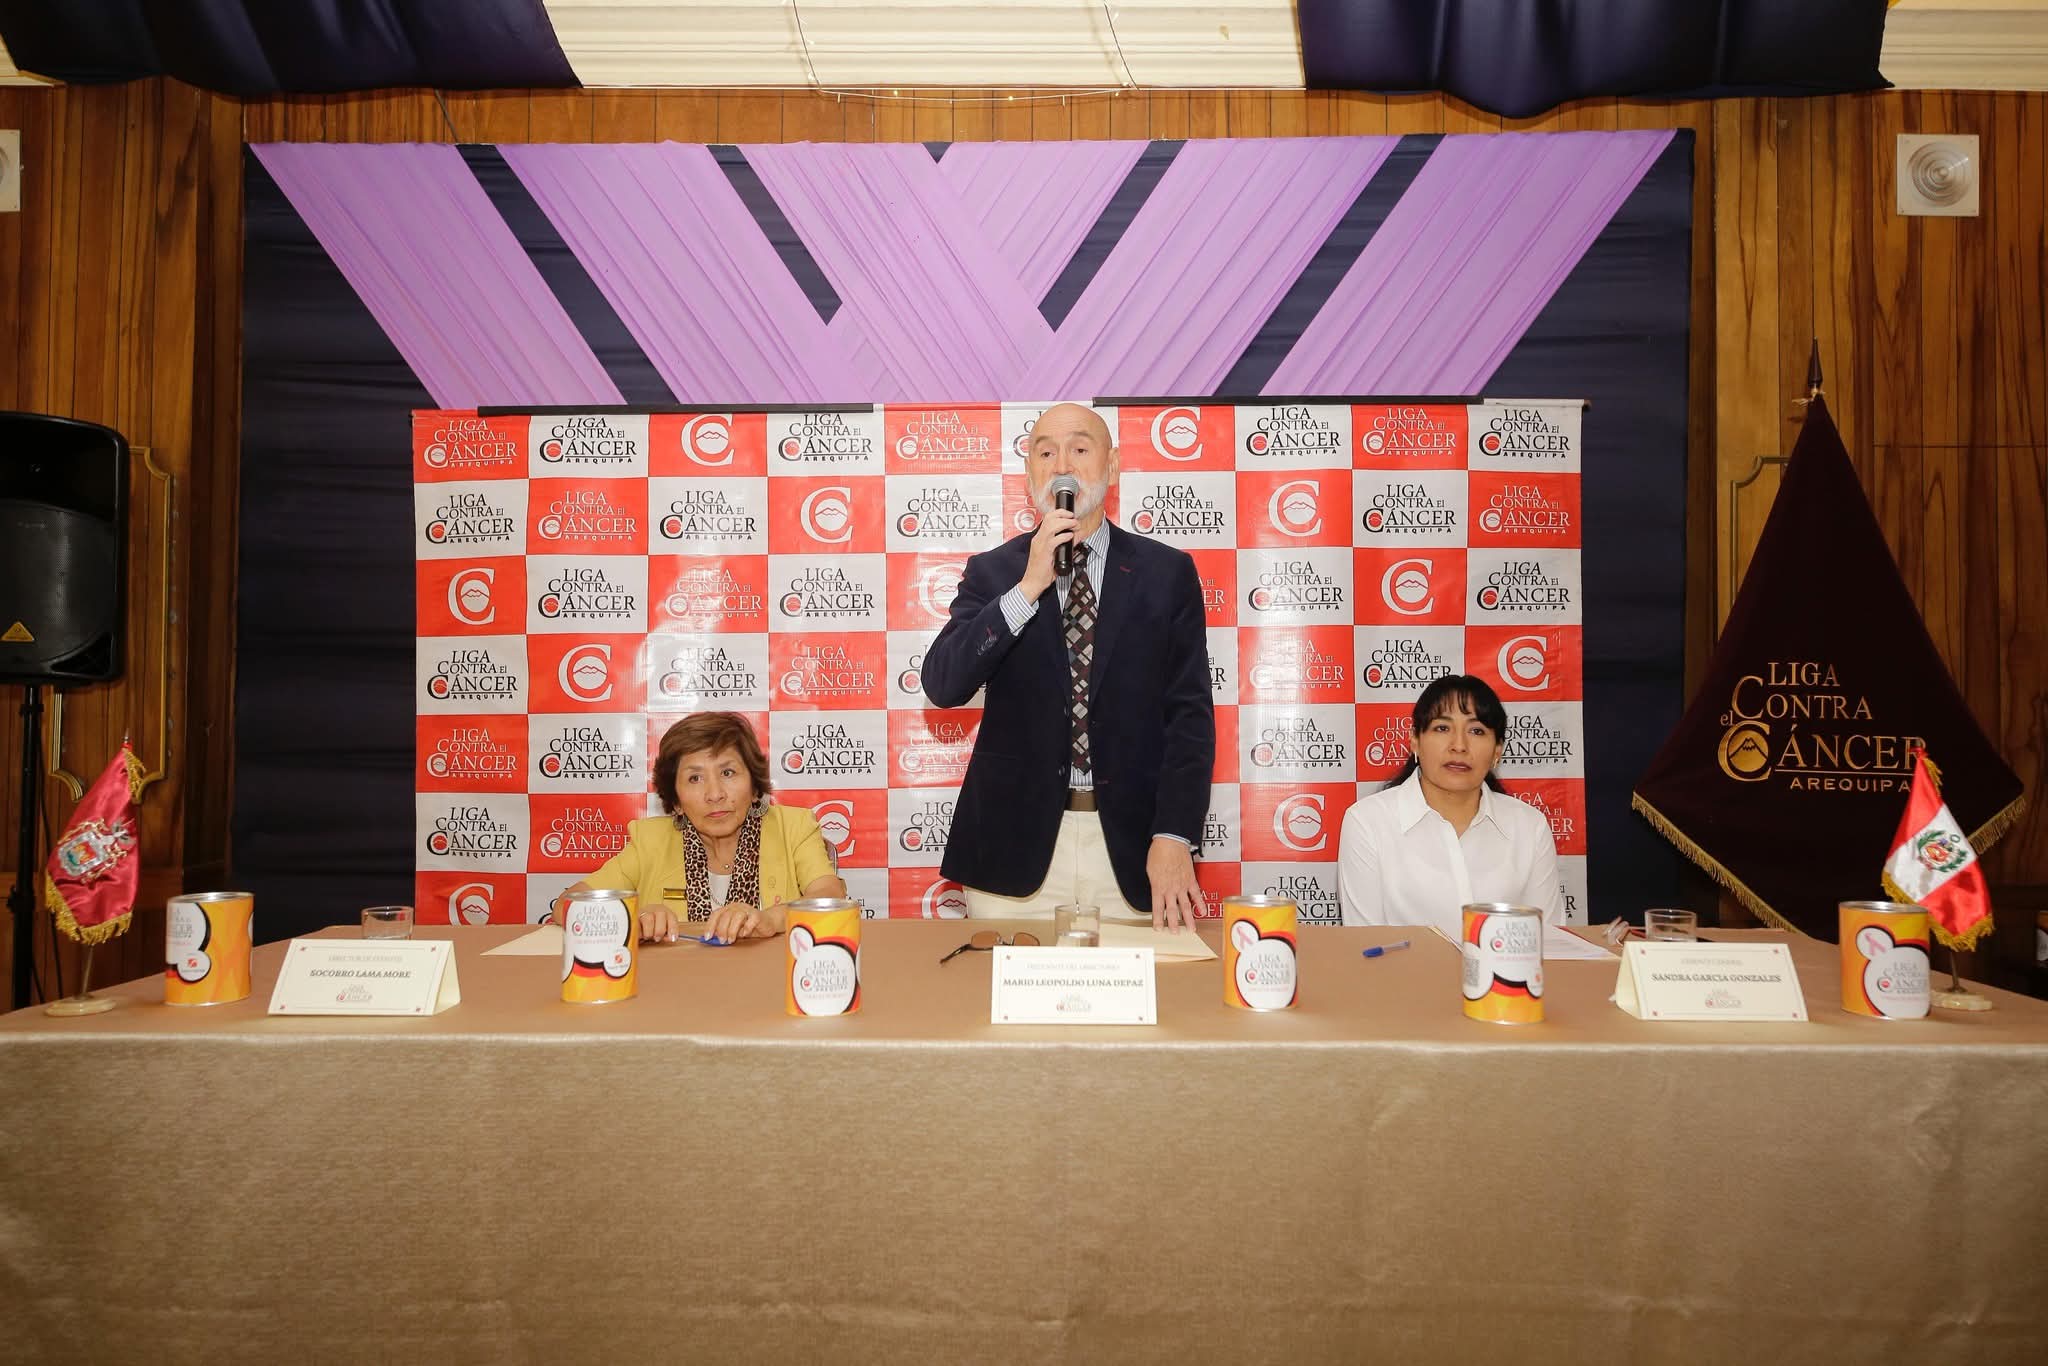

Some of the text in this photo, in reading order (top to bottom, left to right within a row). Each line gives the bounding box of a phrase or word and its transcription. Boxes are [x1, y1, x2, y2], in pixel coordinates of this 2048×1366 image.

[804, 414, 844, 426] LIGA
[921, 412, 961, 424] LIGA
[1271, 407, 1311, 420] LIGA
[1388, 407, 1428, 420] LIGA
[1504, 409, 1543, 422] LIGA
[448, 418, 489, 432] LIGA
[567, 416, 608, 429] LIGA
[907, 422, 968, 434] CONTRA
[1257, 418, 1318, 431] CONTRA
[1374, 417, 1434, 430] CONTRA
[1490, 418, 1549, 432] CONTRA
[434, 429, 495, 442] CONTRA
[552, 425, 614, 438] CONTRA
[789, 423, 850, 436] CONTRA
[779, 436, 872, 461] CÁNCER
[896, 434, 990, 460] CÁNCER
[1246, 430, 1341, 456] CÁNCER
[1363, 430, 1456, 455] CÁNCER
[1480, 431, 1570, 456] CÁNCER
[424, 442, 517, 468] CÁNCER
[540, 438, 637, 463] CÁNCER
[1271, 449, 1337, 457] AREQUIPA
[922, 489, 962, 502] LIGA
[1156, 486, 1196, 498] LIGA
[1386, 484, 1427, 497] LIGA
[1504, 485, 1542, 499] LIGA
[450, 494, 487, 508] LIGA
[565, 492, 607, 505] LIGA
[686, 491, 727, 504] LIGA
[1142, 496, 1202, 509] CONTRA
[1373, 495, 1433, 508] CONTRA
[1490, 494, 1549, 508] CONTRA
[550, 501, 614, 515] CONTRA
[671, 500, 734, 514] CONTRA
[908, 498, 969, 512] CONTRA
[436, 506, 493, 519] CONTRA
[897, 512, 991, 537] CÁNCER
[1132, 509, 1224, 534] CÁNCER
[1363, 507, 1456, 532] CÁNCER
[1480, 507, 1570, 533] CÁNCER
[426, 518, 514, 544] CÁNCER
[539, 514, 636, 539] CÁNCER
[660, 514, 756, 539] CÁNCER
[449, 536, 510, 545] AREQUIPA
[805, 568, 846, 581] LIGA
[1274, 562, 1314, 575] LIGA
[1503, 563, 1542, 575] LIGA
[564, 569, 606, 582] LIGA
[1259, 572, 1321, 586] CONTRA
[1489, 572, 1548, 585] CONTRA
[548, 579, 612, 592] CONTRA
[791, 578, 852, 592] CONTRA
[780, 591, 874, 617] CÁNCER
[1249, 585, 1344, 612] CÁNCER
[1478, 585, 1570, 610] CÁNCER
[538, 592, 635, 617] CÁNCER
[805, 611, 870, 619] AREQUIPA
[806, 646, 846, 659] LIGA
[1385, 640, 1424, 653] LIGA
[451, 650, 490, 663] LIGA
[792, 656, 853, 670] CONTRA
[1371, 650, 1431, 663] CONTRA
[438, 661, 496, 674] CONTRA
[1768, 662, 1840, 687] LIGA
[428, 674, 517, 699] CÁNCER
[781, 670, 875, 696] CÁNCER
[1732, 676, 1873, 720] CONTRA
[1276, 718, 1317, 731] LIGA
[1720, 711, 1734, 726] el
[452, 729, 491, 742] LIGA
[563, 728, 604, 741] LIGA
[807, 725, 847, 738] LIGA
[925, 723, 964, 736] LIGA
[1261, 728, 1324, 742] CONTRA
[438, 739, 496, 752] CONTRA
[549, 739, 611, 752] CONTRA
[792, 735, 853, 748] CONTRA
[782, 748, 875, 774] CÁNCER
[1251, 742, 1346, 768] CÁNCER
[428, 752, 517, 777] CÁNCER
[539, 752, 634, 778] CÁNCER
[807, 768, 871, 776] AREQUIPA
[1790, 776, 1912, 793] AREQUIPA
[450, 806, 490, 821] LIGA
[566, 808, 605, 821] LIGA
[436, 817, 496, 831] CONTRA
[551, 818, 612, 832] CONTRA
[427, 831, 516, 855] CÁNCER
[448, 851, 511, 859] AREQUIPA
[1279, 876, 1319, 889] LIGA
[584, 906, 606, 914] LIGA
[814, 960, 836, 968] LIGA
[1003, 978, 1034, 987] MARIO
[1036, 978, 1085, 987] LEOPOLDO
[1086, 978, 1111, 987] LUNA
[1652, 973, 1691, 982] SANDRA
[1730, 974, 1781, 983] GONZALES
